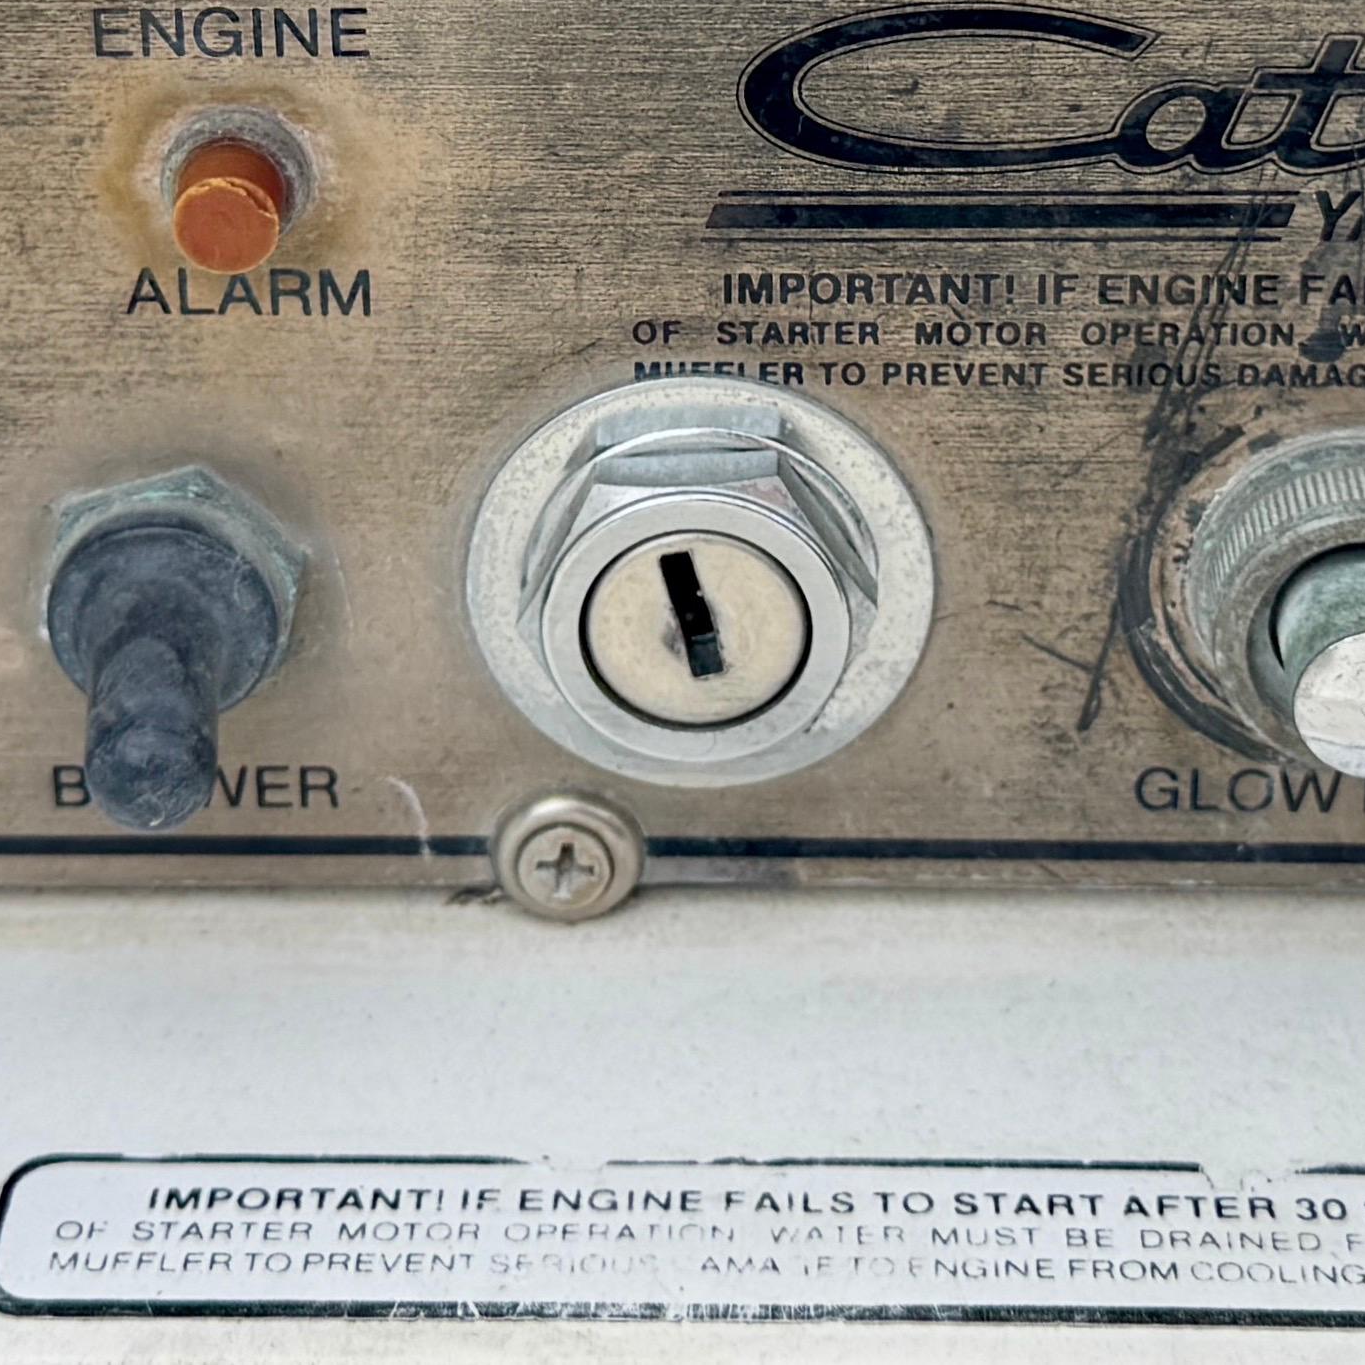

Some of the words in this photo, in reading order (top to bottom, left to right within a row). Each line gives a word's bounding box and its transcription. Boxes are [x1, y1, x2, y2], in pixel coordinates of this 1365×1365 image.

[93, 7, 370, 58] ENGINE
[127, 267, 372, 316] ALARM
[722, 272, 1015, 306] IMPORTANT!
[1037, 273, 1080, 306] IF
[1098, 273, 1279, 306] ENGINE
[632, 320, 683, 345] OF
[717, 321, 880, 346] STARTER
[915, 321, 1047, 347] MOTOR
[820, 362, 865, 386] TO
[882, 362, 1046, 387] PREVENT
[1062, 363, 1220, 387] SERIOUS
[52, 764, 338, 808] BWER
[1133, 767, 1342, 815] GLOW
[148, 1187, 444, 1212] IMPORTANT!
[460, 1188, 499, 1212] IF
[519, 1188, 705, 1213] ENGINE
[724, 1190, 855, 1215] FAILS
[874, 1191, 935, 1215] TO
[953, 1192, 1104, 1217] START
[1123, 1194, 1277, 1220] AFTER
[1296, 1197, 1348, 1223] 30
[132, 1220, 313, 1241] STARTER
[337, 1221, 479, 1242] MOTOR
[770, 1225, 903, 1246] WATER
[931, 1226, 1036, 1247] MUST
[1066, 1227, 1114, 1248] BE
[1141, 1229, 1322, 1253] DRAINED
[244, 1252, 292, 1273] TO
[303, 1252, 476, 1274] PREVENT
[853, 1255, 902, 1277] TO
[909, 1256, 1056, 1279] ENGINE
[1068, 1258, 1179, 1281] FROM
